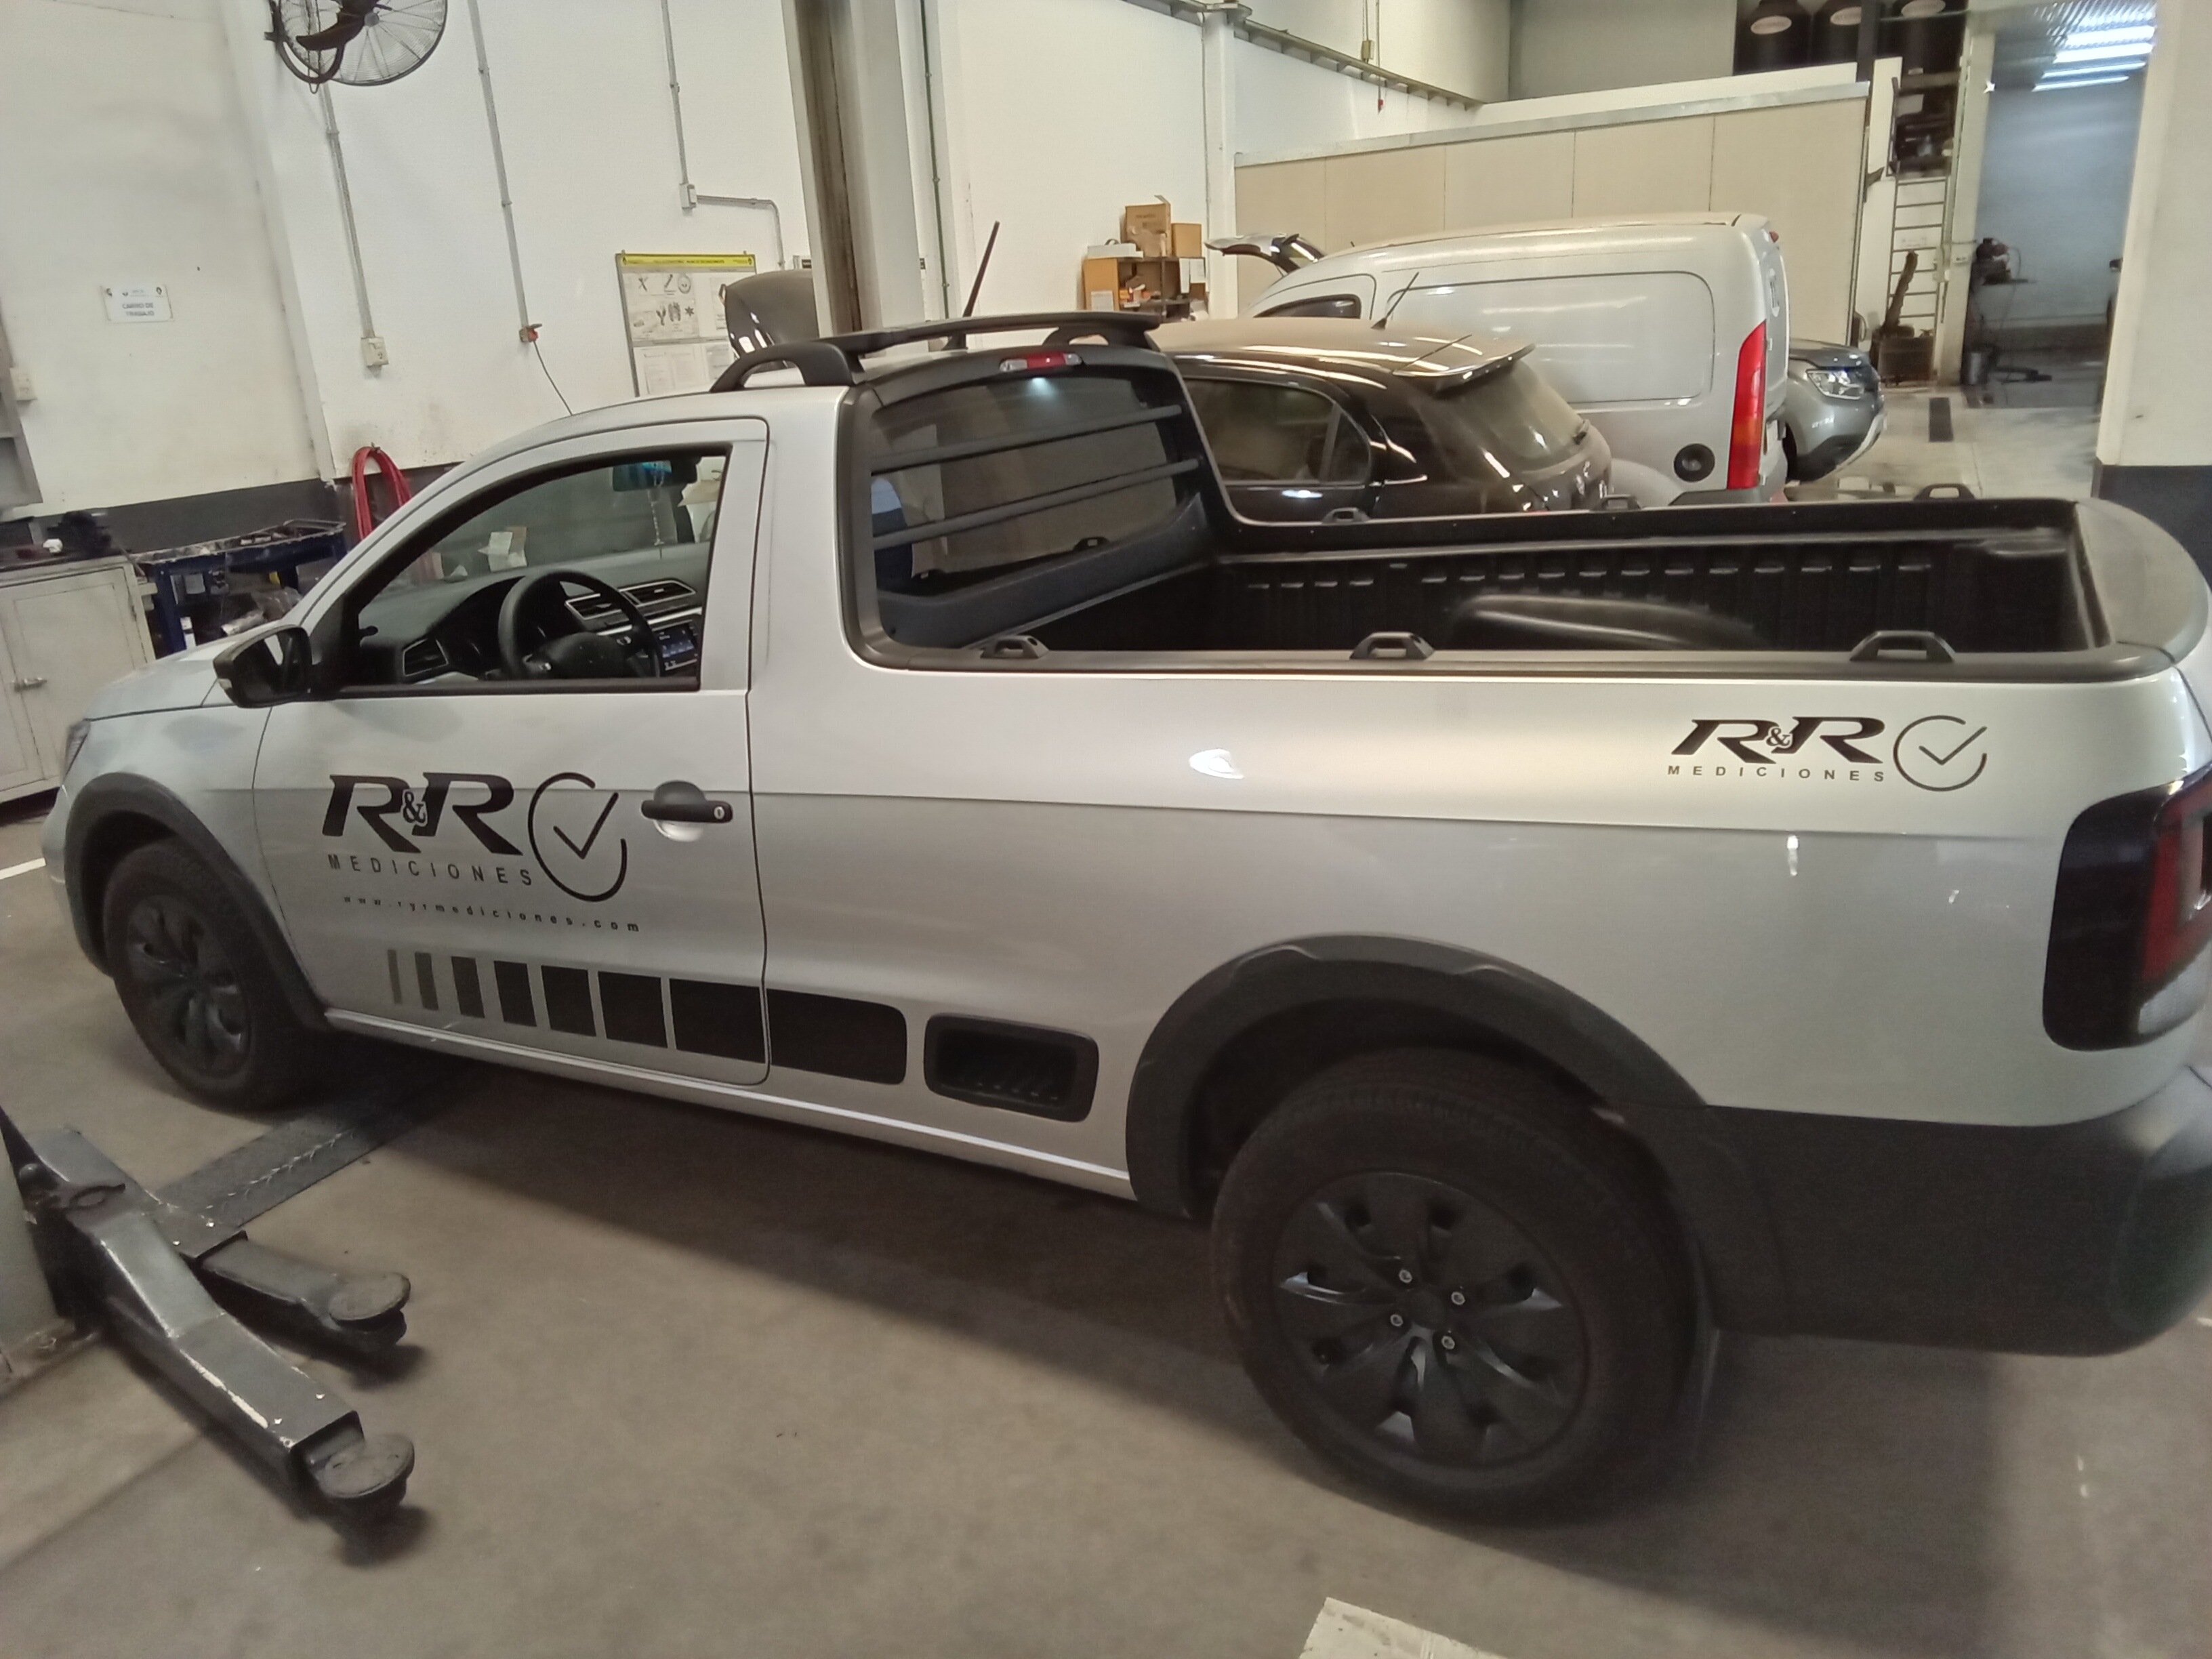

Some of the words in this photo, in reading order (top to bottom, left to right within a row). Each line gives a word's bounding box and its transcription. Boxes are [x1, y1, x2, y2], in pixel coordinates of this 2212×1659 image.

[1671, 716, 1885, 764] R&R
[1668, 765, 1885, 782] MEDICIONES
[322, 771, 524, 856] R&R
[328, 854, 533, 886] MEDICIONES
[344, 896, 640, 933] www.ryrmediciones.com
